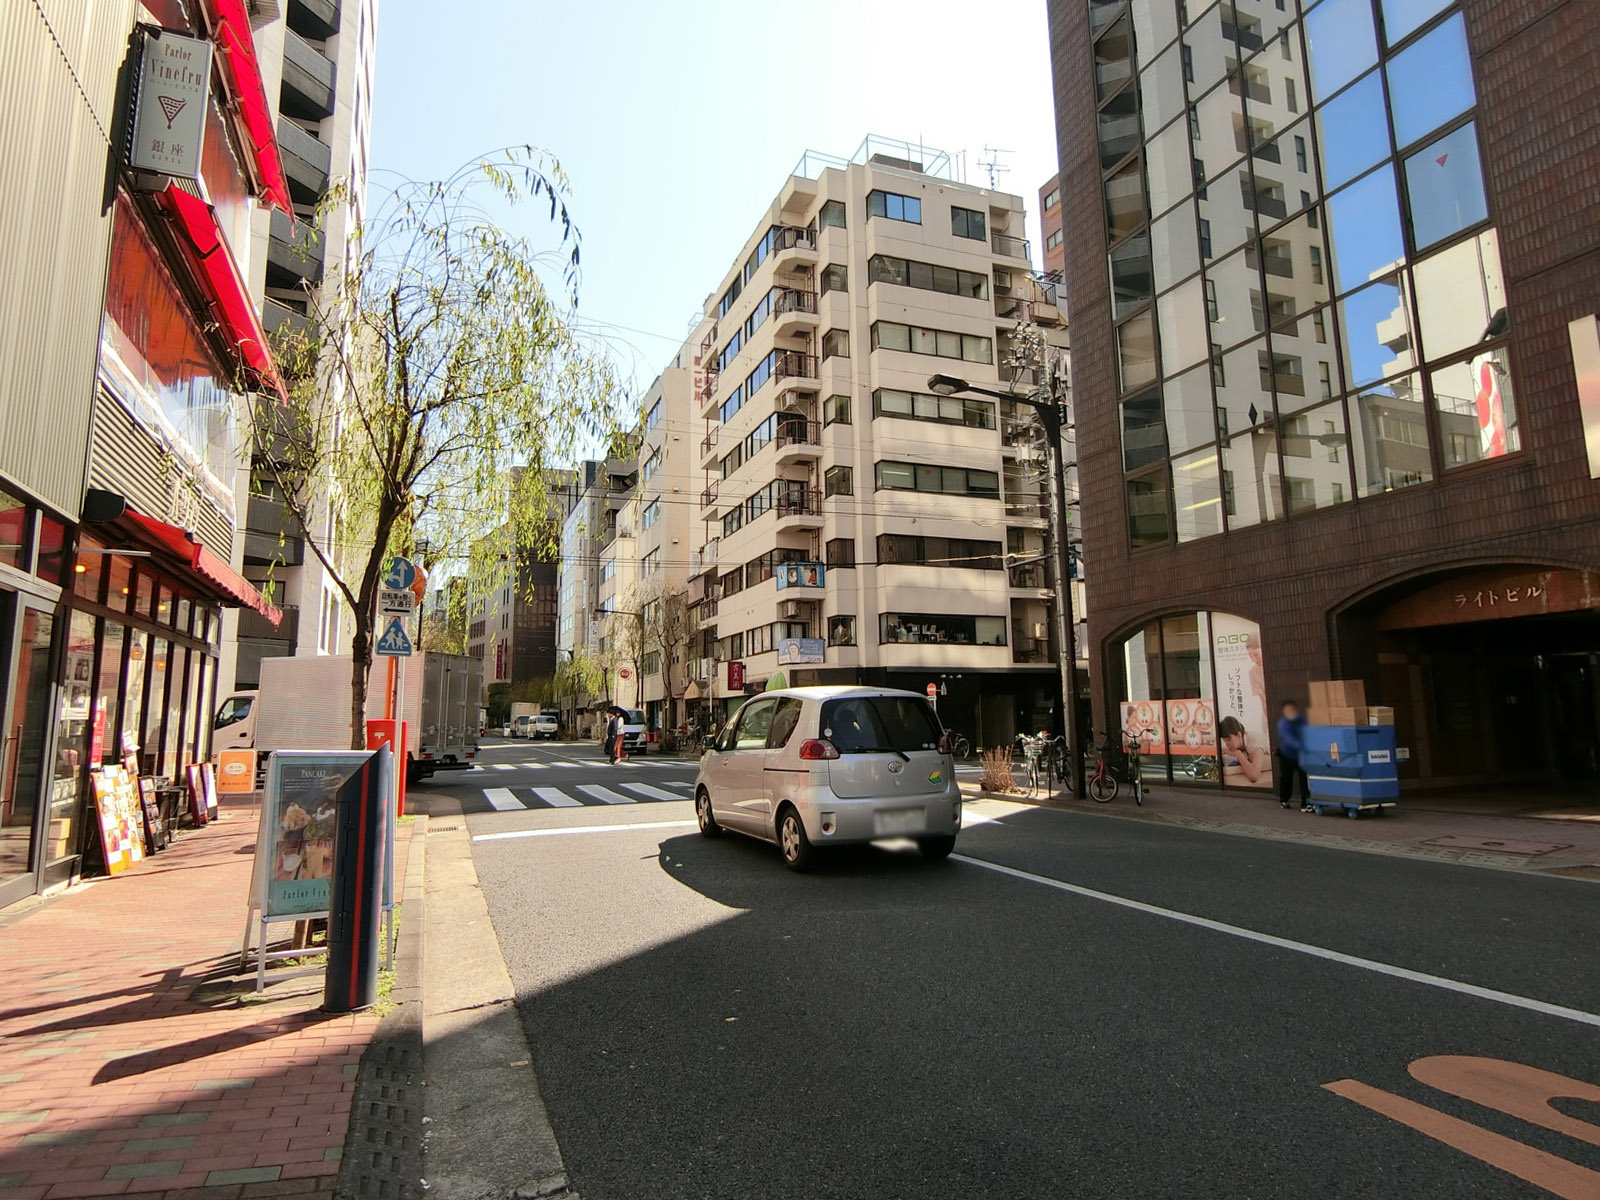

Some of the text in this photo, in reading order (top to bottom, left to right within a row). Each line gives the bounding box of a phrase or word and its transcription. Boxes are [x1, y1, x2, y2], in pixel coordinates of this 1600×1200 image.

[165, 43, 192, 61] Parlor
[151, 58, 202, 86] Vinefru
[381, 600, 412, 609] 一方通行
[1455, 586, 1542, 609] ライトビル
